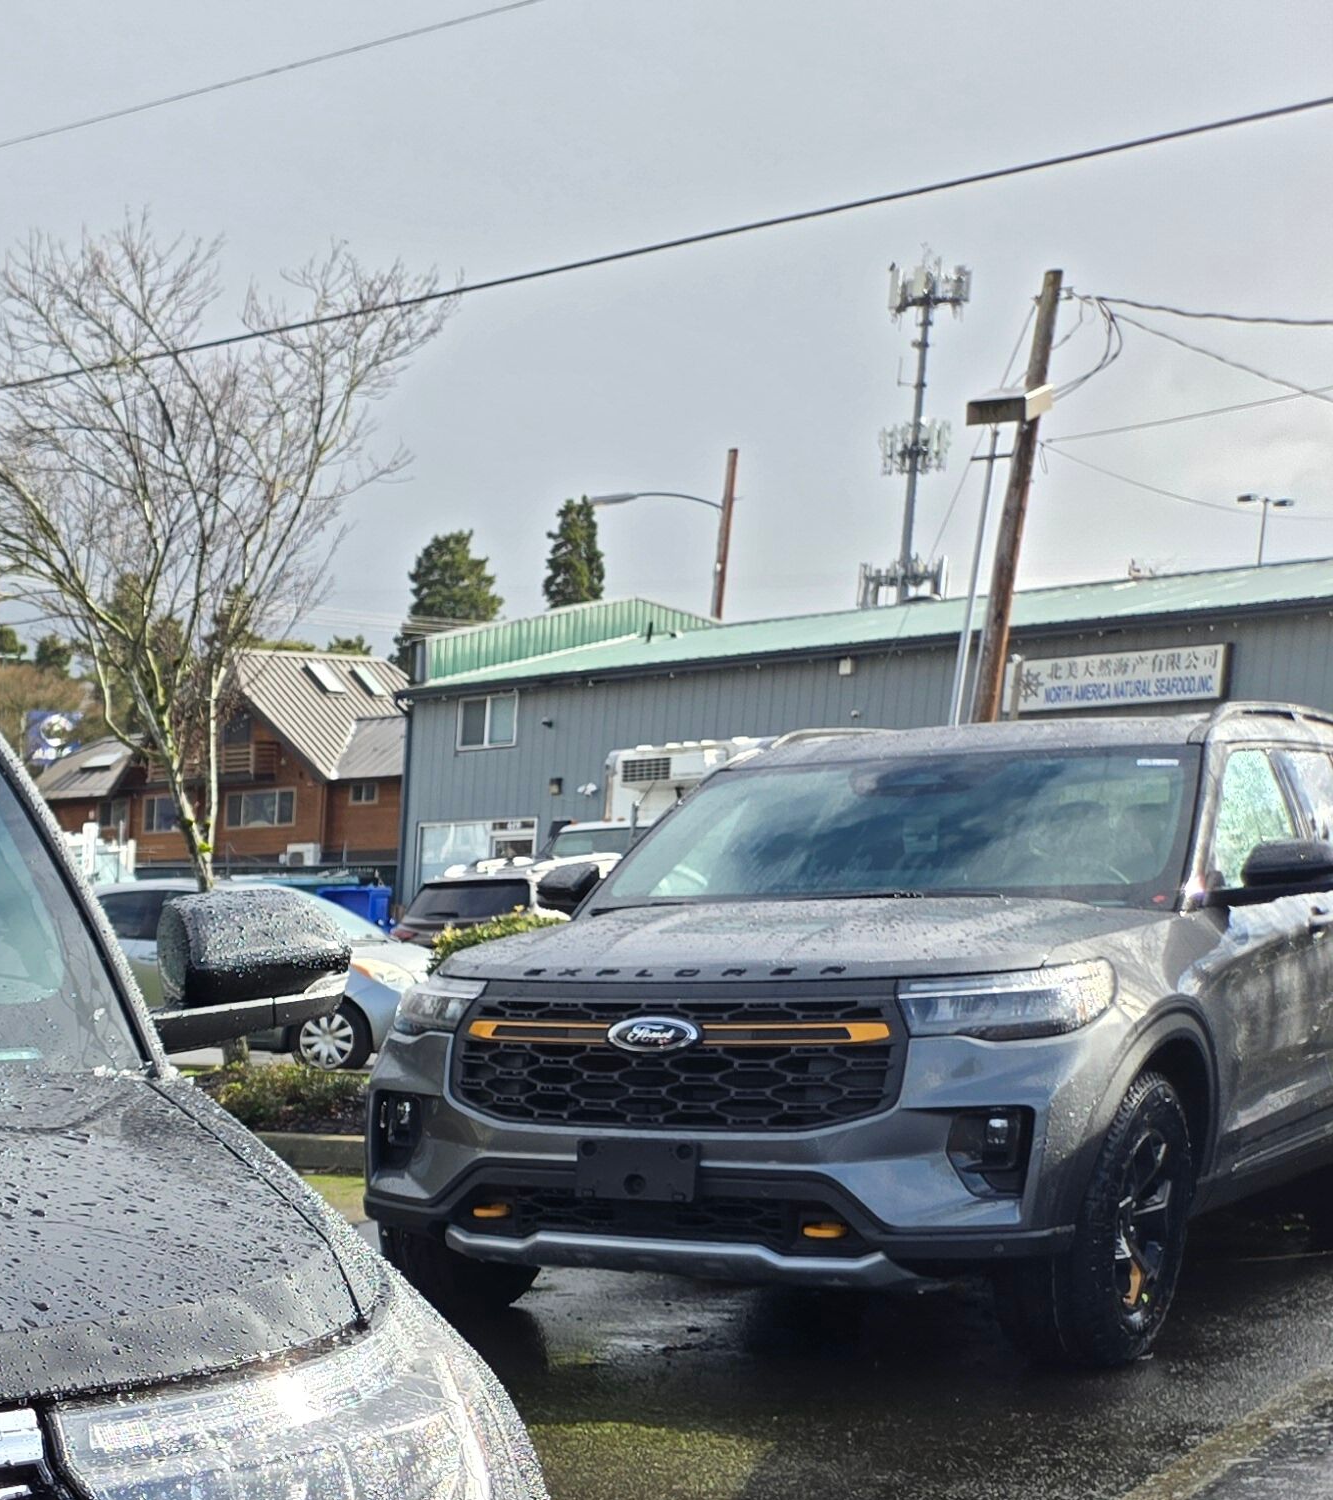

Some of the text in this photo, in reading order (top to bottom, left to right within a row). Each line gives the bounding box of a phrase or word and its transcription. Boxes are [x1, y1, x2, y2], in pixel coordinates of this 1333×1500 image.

[1044, 685, 1073, 704] NORTH
[1074, 682, 1111, 702] AMERICA
[1112, 678, 1152, 699] NATURAL
[523, 965, 848, 978] EXPLORER
[626, 1024, 676, 1043] Ford
